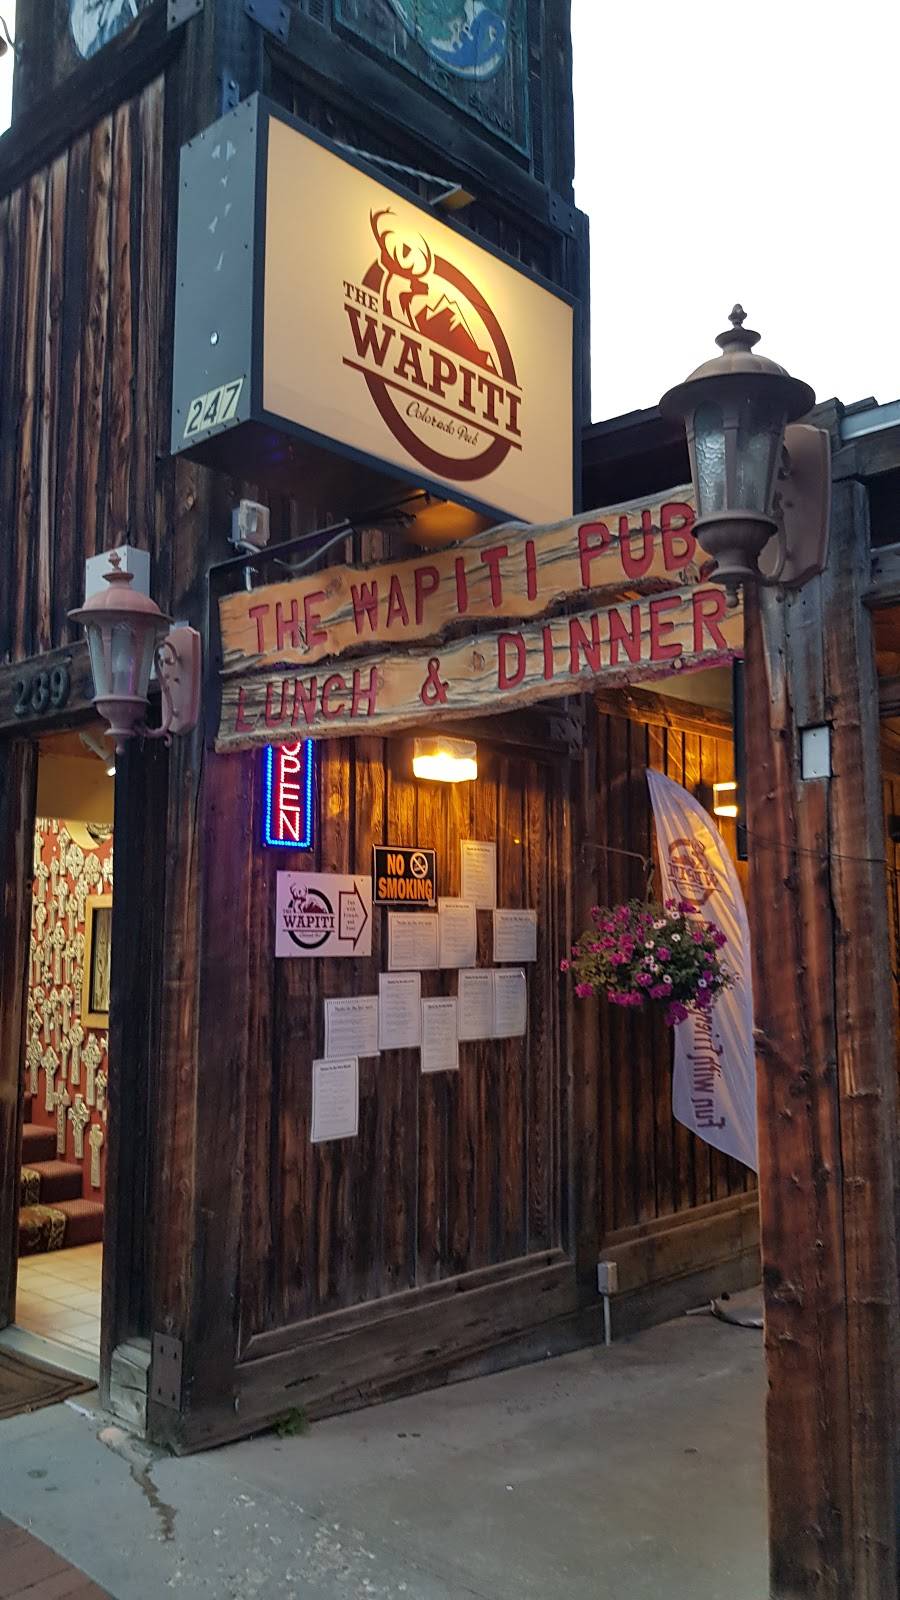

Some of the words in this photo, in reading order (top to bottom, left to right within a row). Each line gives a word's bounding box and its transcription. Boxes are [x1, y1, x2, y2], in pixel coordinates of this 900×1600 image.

[342, 280, 379, 313] THE
[344, 302, 522, 437] WAPITI
[187, 384, 241, 434] 247
[406, 401, 455, 436] Colorado
[457, 425, 479, 446] Pub
[249, 592, 328, 654] THE
[350, 540, 538, 635] WAPITI
[577, 501, 698, 590] PUB
[234, 667, 378, 732] LUNCH
[420, 657, 448, 706] &
[498, 589, 728, 690] DINNER
[387, 853, 405, 876] NO
[378, 876, 433, 900] SMOKING
[283, 915, 335, 928] WAPITI
